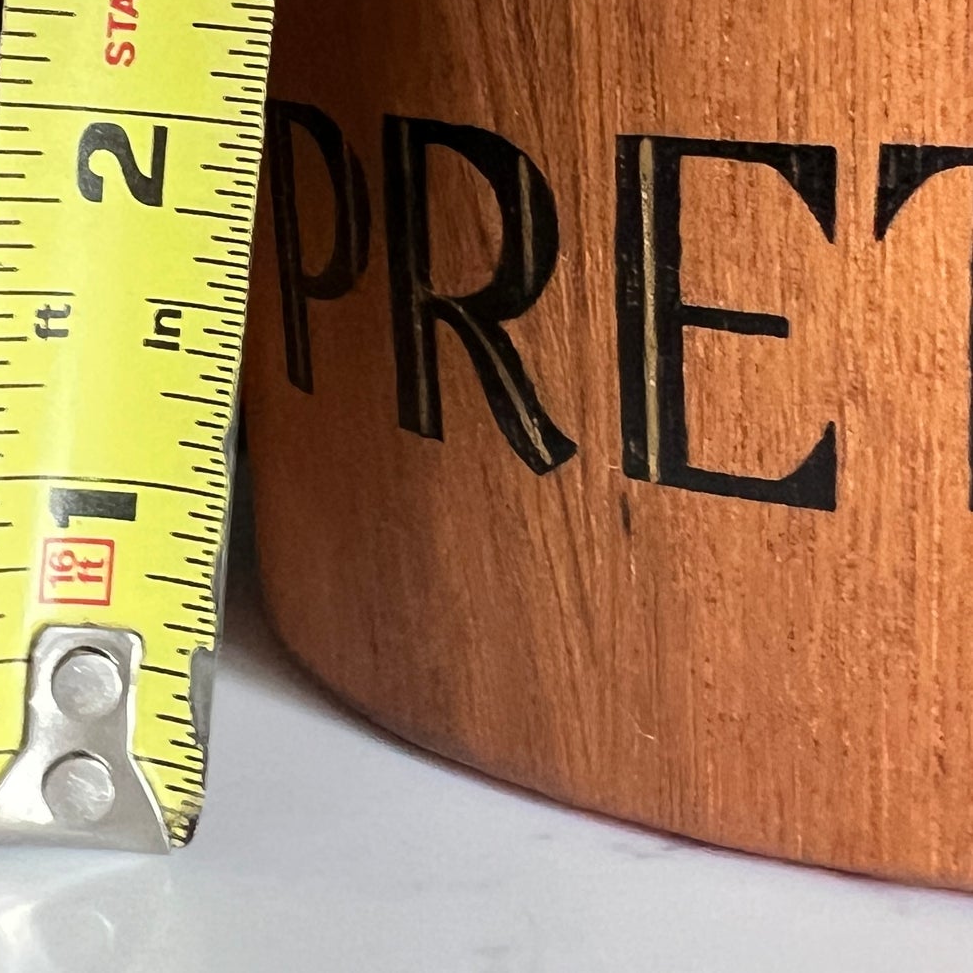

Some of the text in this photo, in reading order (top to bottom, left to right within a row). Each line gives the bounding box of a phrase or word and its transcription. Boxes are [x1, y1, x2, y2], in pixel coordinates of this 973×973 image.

[77, 122, 168, 207] 2
[33, 303, 72, 340] ft
[49, 487, 138, 528] 1
[48, 549, 76, 587] 16
[75, 556, 104, 583] ft
